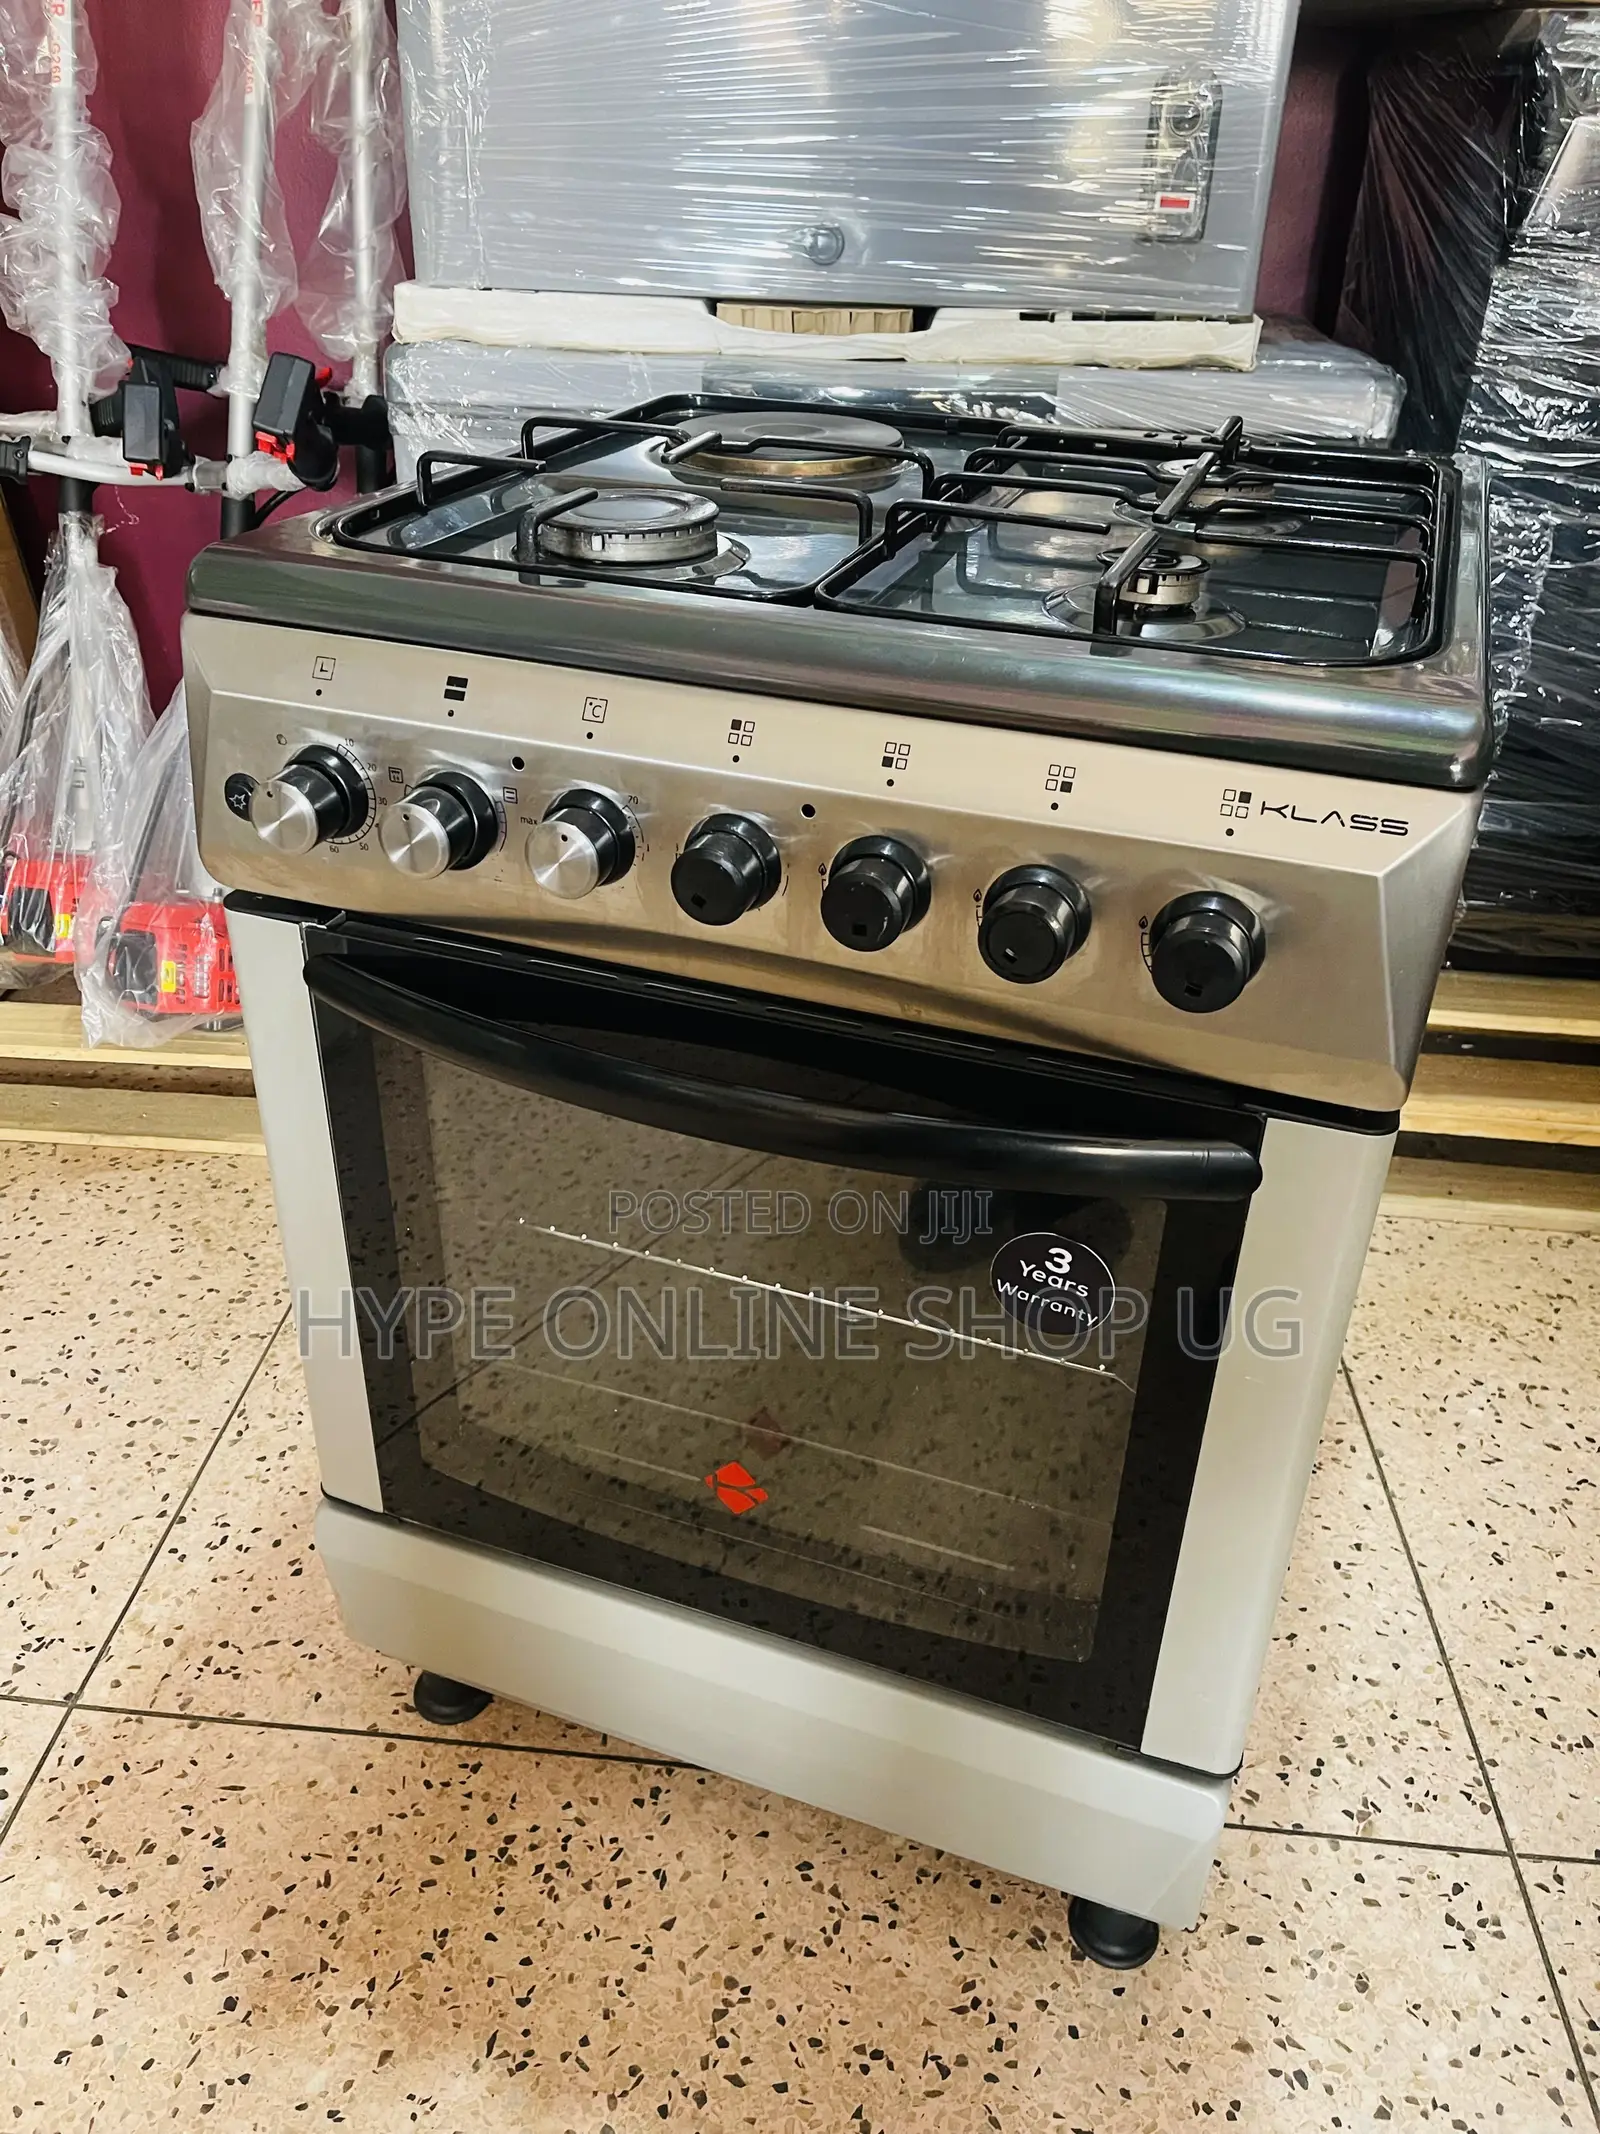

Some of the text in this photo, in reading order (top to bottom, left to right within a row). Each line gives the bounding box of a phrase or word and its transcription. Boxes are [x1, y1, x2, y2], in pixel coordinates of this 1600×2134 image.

[345, 738, 355, 747] 10
[367, 762, 378, 772] 20
[378, 796, 388, 806] 30
[627, 795, 639, 805] 70
[520, 816, 539, 826] max
[1260, 801, 1410, 837] KLASS
[329, 845, 339, 854] 60
[359, 842, 369, 852] 50
[1045, 1247, 1074, 1275] 3
[1019, 1259, 1089, 1298] Years
[996, 1278, 1099, 1327] Warranty
